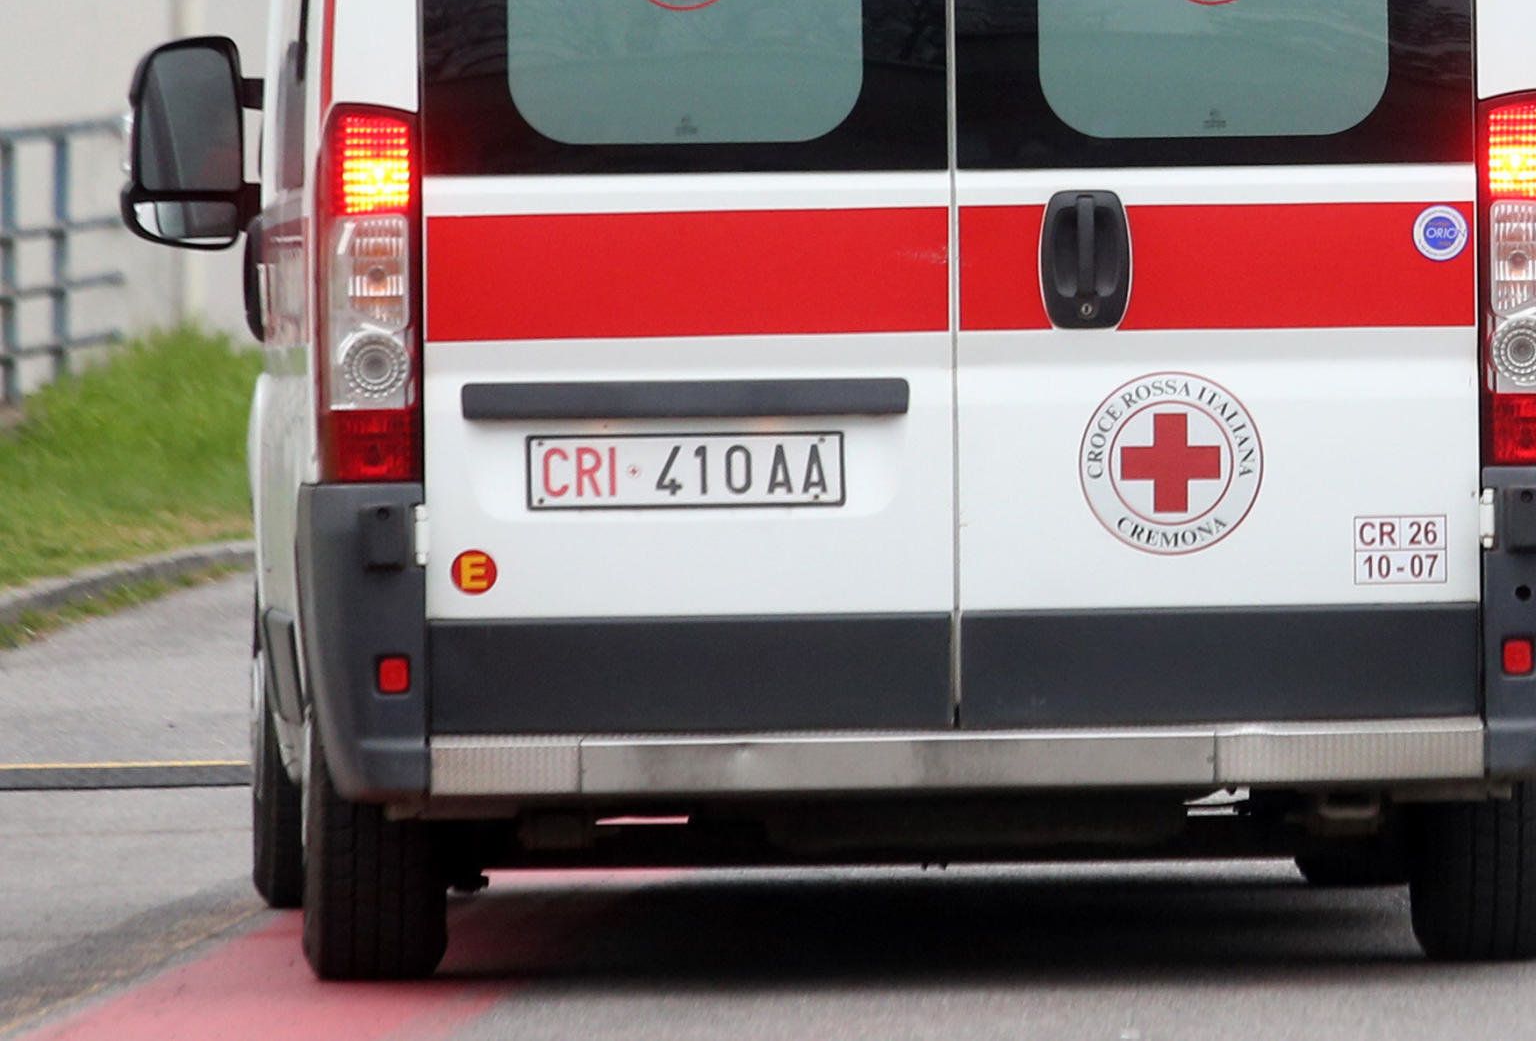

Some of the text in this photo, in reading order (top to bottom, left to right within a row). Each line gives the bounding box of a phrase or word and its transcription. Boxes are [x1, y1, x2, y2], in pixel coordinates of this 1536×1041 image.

[1087, 379, 1256, 479] CROCE ROSSA ITALIANA
[542, 446, 617, 498] CRI
[1116, 516, 1229, 548] CREMONA
[1359, 520, 1437, 547] CR 26
[461, 556, 488, 589] E
